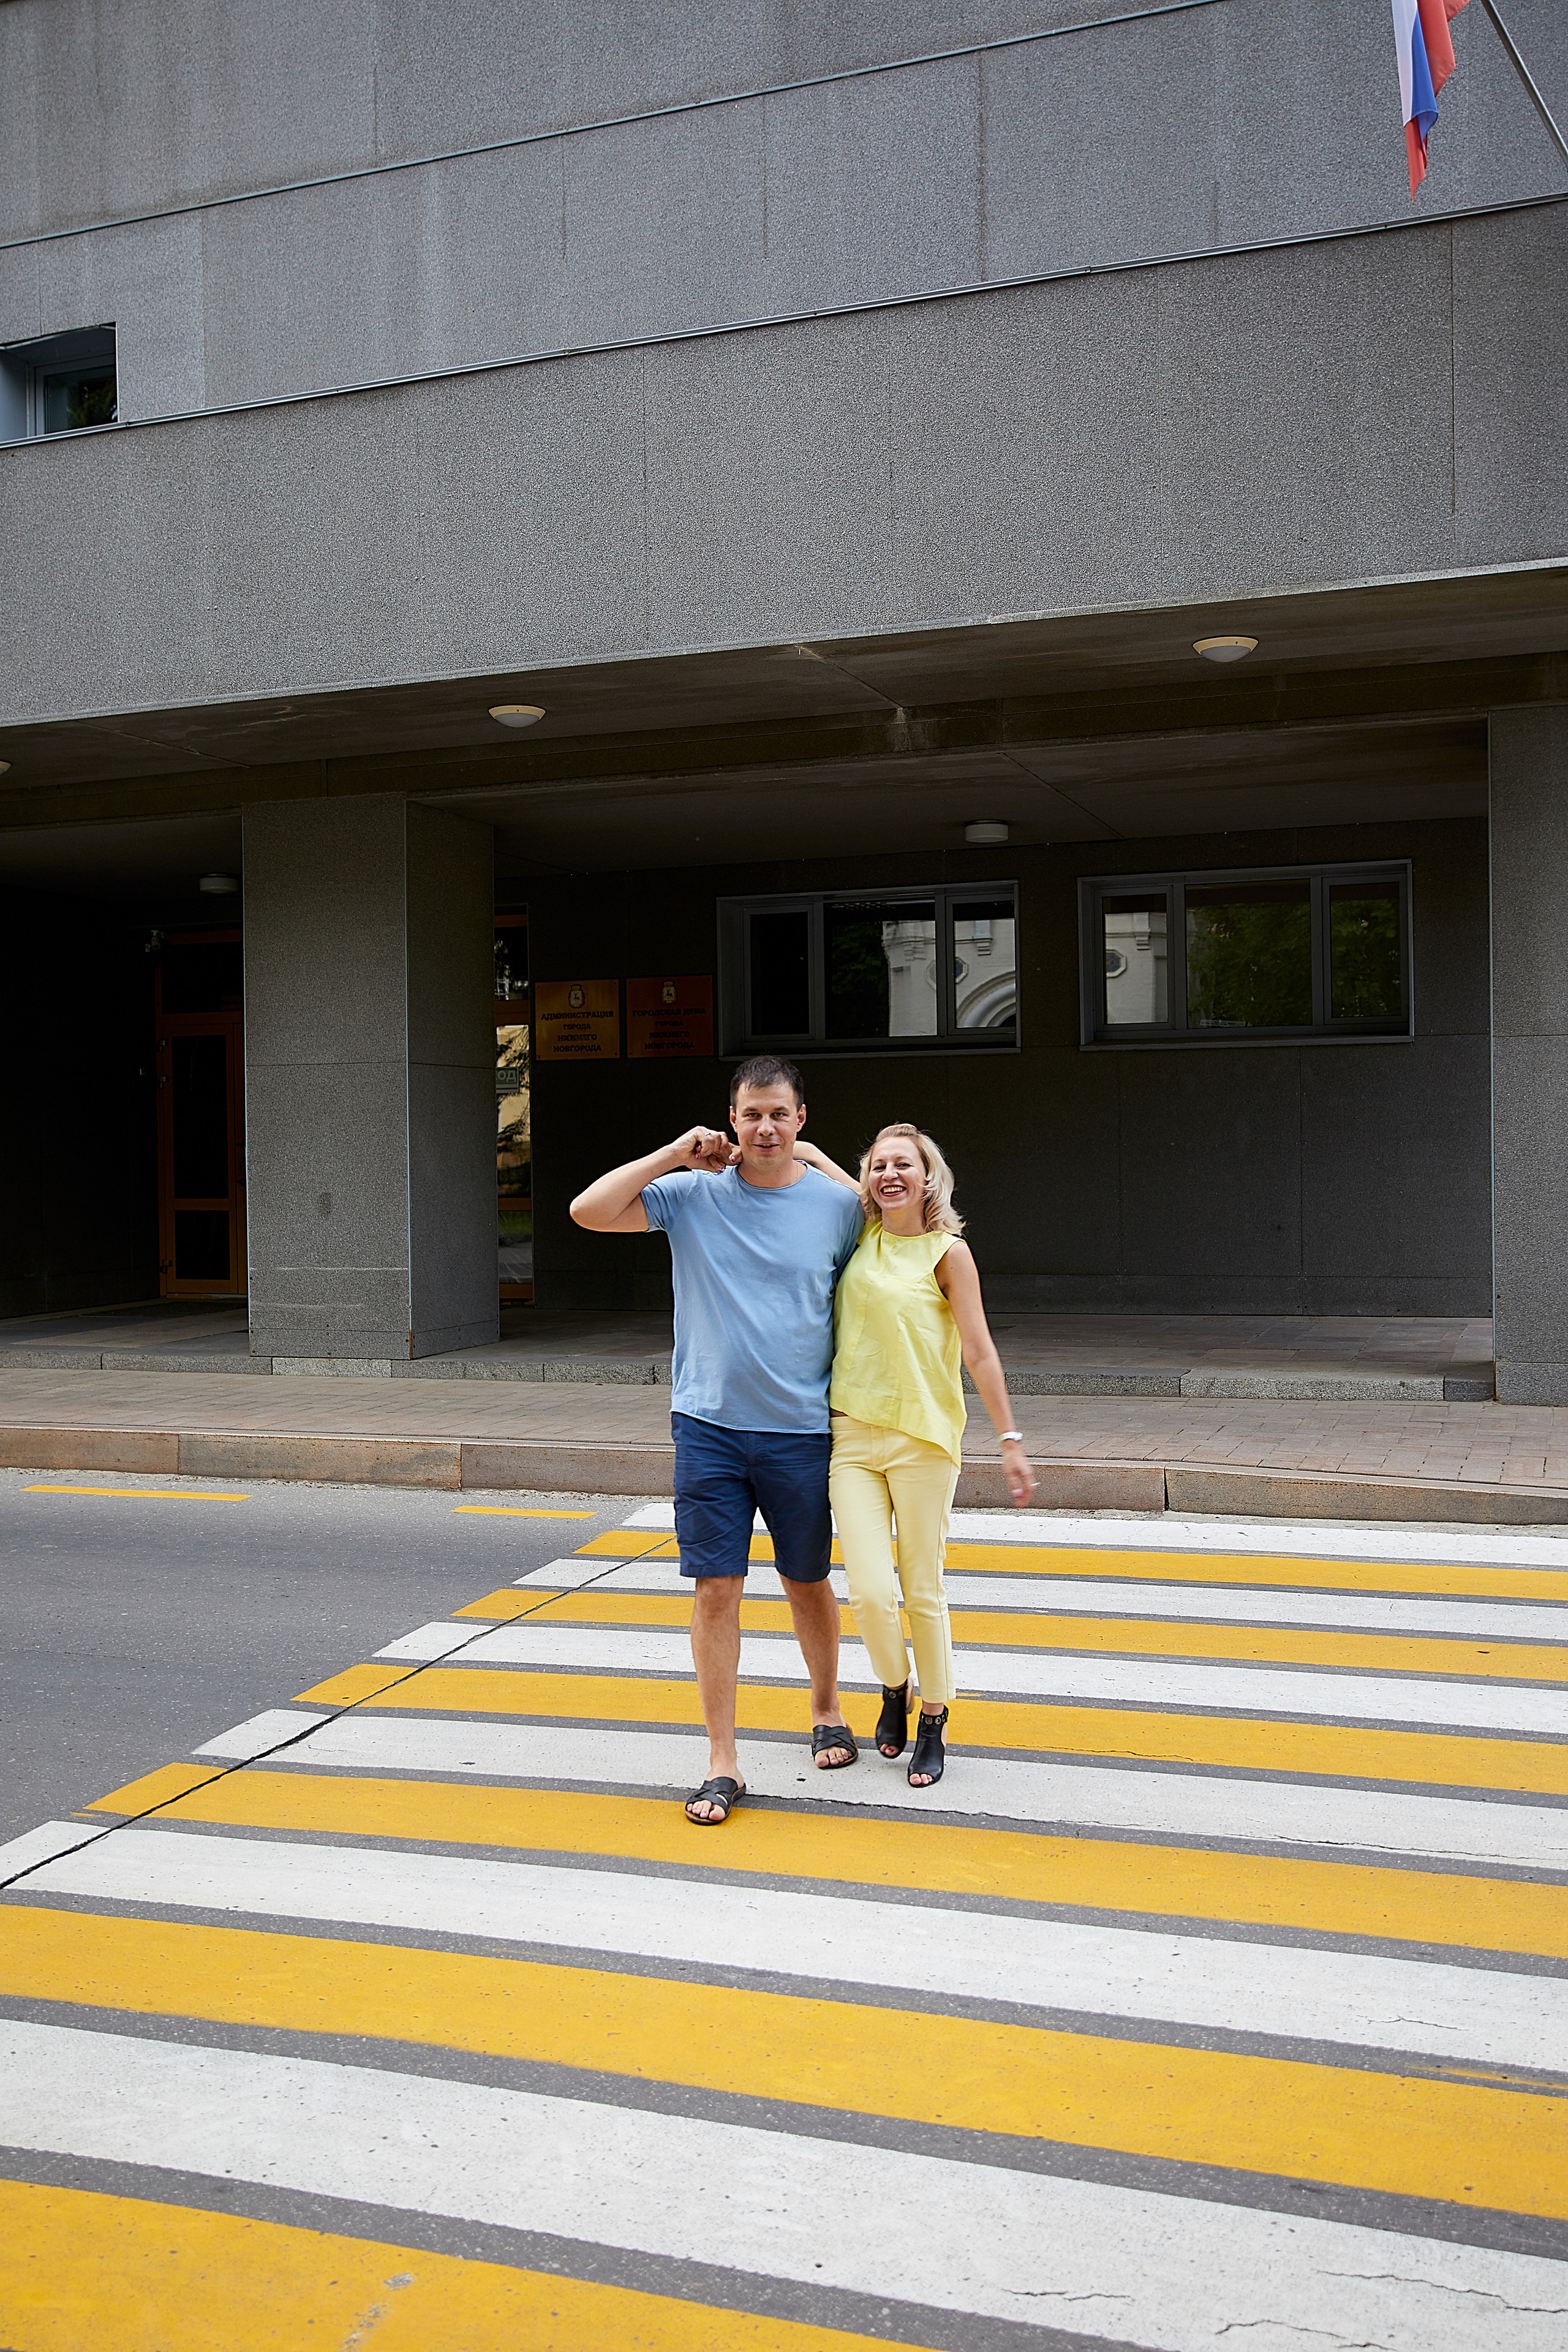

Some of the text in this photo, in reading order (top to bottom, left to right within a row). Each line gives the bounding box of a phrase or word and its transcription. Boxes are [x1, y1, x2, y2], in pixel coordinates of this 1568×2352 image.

[541, 1011, 614, 1021] АДМИНИСТРАЦИЯ
[632, 1007, 706, 1017] ГОРОДСКАЯ ДУМА
[496, 1070, 516, 1082] ОД
